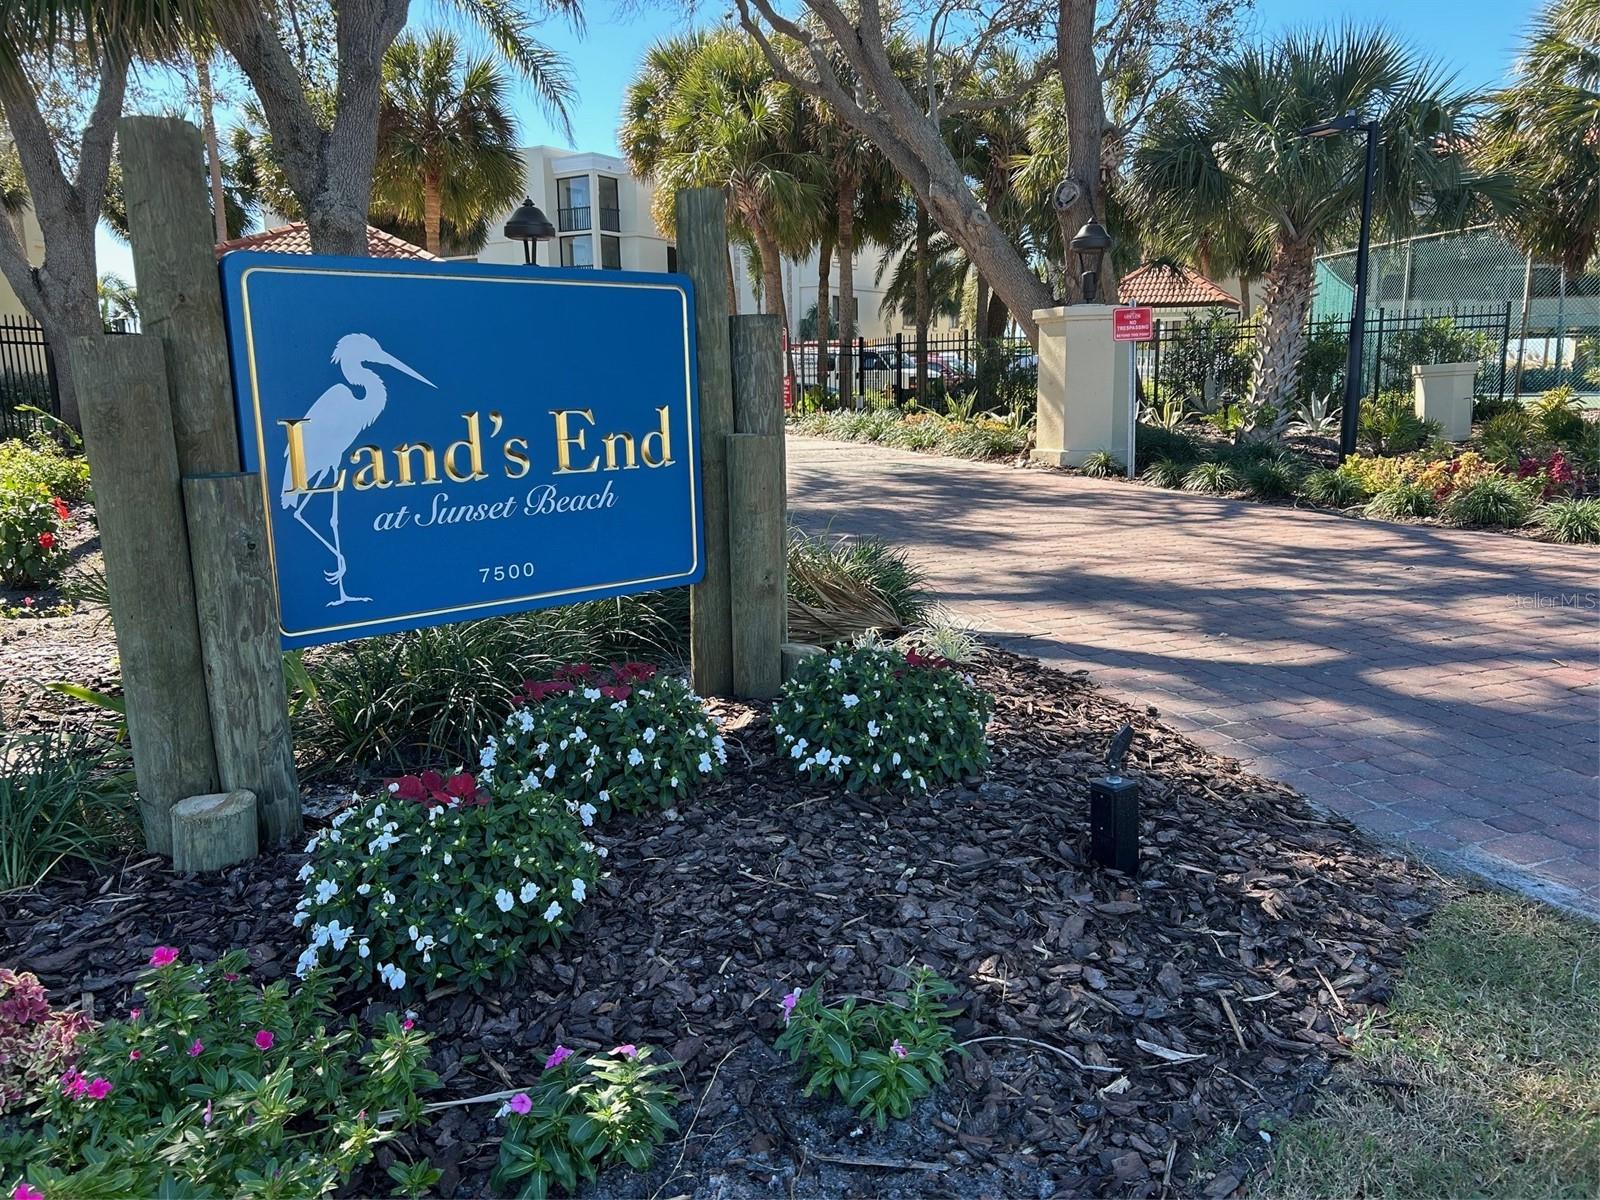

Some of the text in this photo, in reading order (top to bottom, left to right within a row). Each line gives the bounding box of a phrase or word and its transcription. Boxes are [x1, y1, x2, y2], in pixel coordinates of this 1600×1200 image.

[276, 404, 676, 495] Land’s End
[373, 480, 619, 531] at Sunset Beach
[479, 562, 535, 584] 7500
